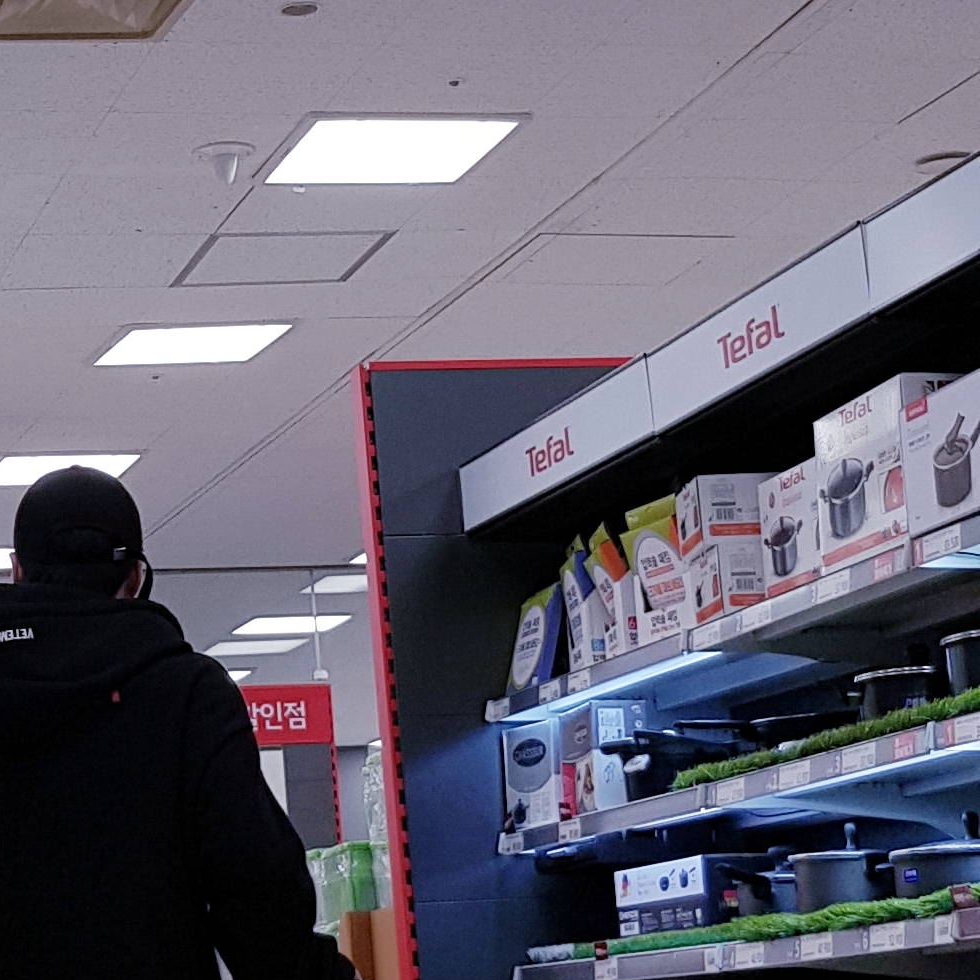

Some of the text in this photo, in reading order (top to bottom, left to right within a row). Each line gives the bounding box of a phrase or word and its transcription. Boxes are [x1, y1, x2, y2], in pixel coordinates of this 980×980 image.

[717, 304, 785, 369] Tefal
[837, 396, 873, 427] Tefal
[525, 426, 574, 477] Tefal
[778, 467, 806, 492] Tefal
